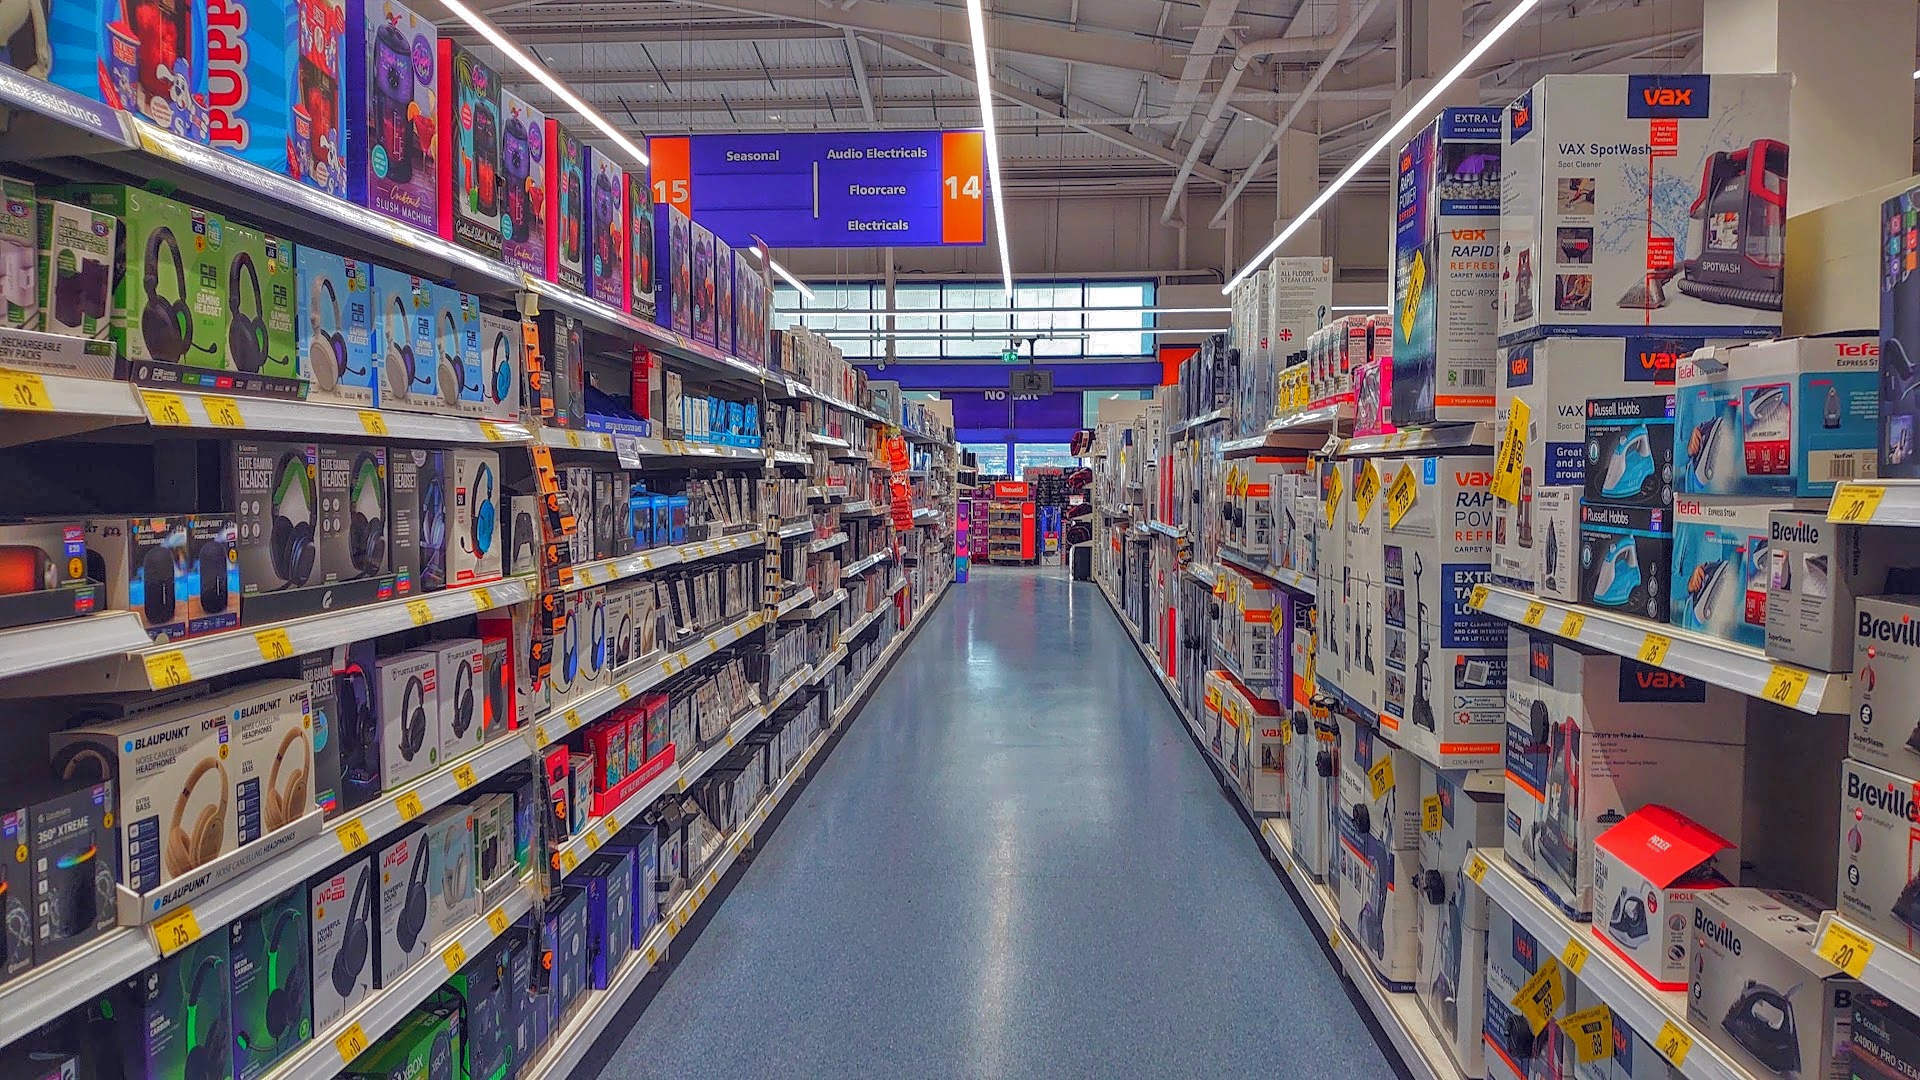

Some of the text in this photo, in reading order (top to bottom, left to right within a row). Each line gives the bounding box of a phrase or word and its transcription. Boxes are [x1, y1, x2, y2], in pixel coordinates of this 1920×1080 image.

[1642, 88, 1693, 106] vax
[1454, 113, 1489, 124] EXTRA
[1513, 105, 1529, 129] vax
[726, 150, 780, 162] Seasonal
[827, 147, 928, 159] Audio Electricals
[1558, 143, 1652, 158] VAX SpotWash
[1558, 161, 1573, 169] Spot
[653, 179, 690, 203] 15
[849, 185, 906, 195] Floorcare
[944, 175, 982, 199] 14
[390, 185, 420, 207] Cocktail
[376, 196, 433, 227] SLUSH MACHINE
[847, 220, 909, 231] Electricals
[1452, 229, 1486, 241] vax
[1451, 246, 1494, 257] RAPID
[504, 254, 543, 277] SLUSH MACHINE
[1702, 261, 1741, 274] SPOTWASH
[195, 294, 220, 306] GAMING
[194, 303, 222, 317] HEADSET
[2, 337, 62, 352] RECHARGEABLE
[17, 349, 41, 360] PACKS
[1511, 358, 1528, 375] vax
[1837, 359, 1869, 367] EXPRESS
[1677, 364, 1695, 380] Tefal
[984, 390, 1006, 400] NO
[1558, 405, 1584, 416] VAX
[1593, 400, 1640, 417] Russell Hobbs
[1557, 422, 1573, 431] Spot
[1496, 450, 1507, 482] SPOTWASH
[1504, 420, 1514, 450] CLEANER
[1515, 439, 1524, 471] £89
[1556, 447, 1583, 456] Great
[238, 457, 273, 470] ELITE GAMING
[320, 459, 350, 471] ELITE GAMING
[1556, 459, 1574, 468] and
[239, 470, 273, 489] HEADSET
[321, 471, 350, 488] HEADSET
[393, 474, 417, 488] HEADSET
[1676, 500, 1701, 515] Tefal
[1708, 508, 1736, 518] EXPRESS STEAM
[1587, 507, 1629, 525] Russell Hobbs
[193, 520, 223, 529] BLAUPUNKT
[1771, 520, 1819, 544] Breville
[1532, 650, 1549, 671] vax
[1636, 671, 1686, 689] vax
[1772, 681, 1792, 702] £20
[241, 699, 281, 718] BLAUPUNKT
[135, 726, 190, 750] BLAUPUNKT
[241, 725, 273, 741] HEADPHONES
[135, 756, 177, 775] HEADPHONES
[242, 765, 254, 775] BASS
[135, 802, 152, 813] BASS
[57, 815, 90, 835] XTREME
[263, 831, 296, 853] HEADPHONES
[383, 852, 396, 868] JVC
[162, 872, 212, 907] BLAUPUNKT
[316, 888, 332, 906] JVC
[316, 917, 342, 940] POWERFUL
[316, 929, 333, 944] SOUND
[1694, 907, 1742, 957] Breville
[1832, 943, 1854, 969] £20
[1662, 1038, 1678, 1058] £20
[1853, 1031, 1879, 1056] 2400W
[1880, 1046, 1897, 1066] PRO
